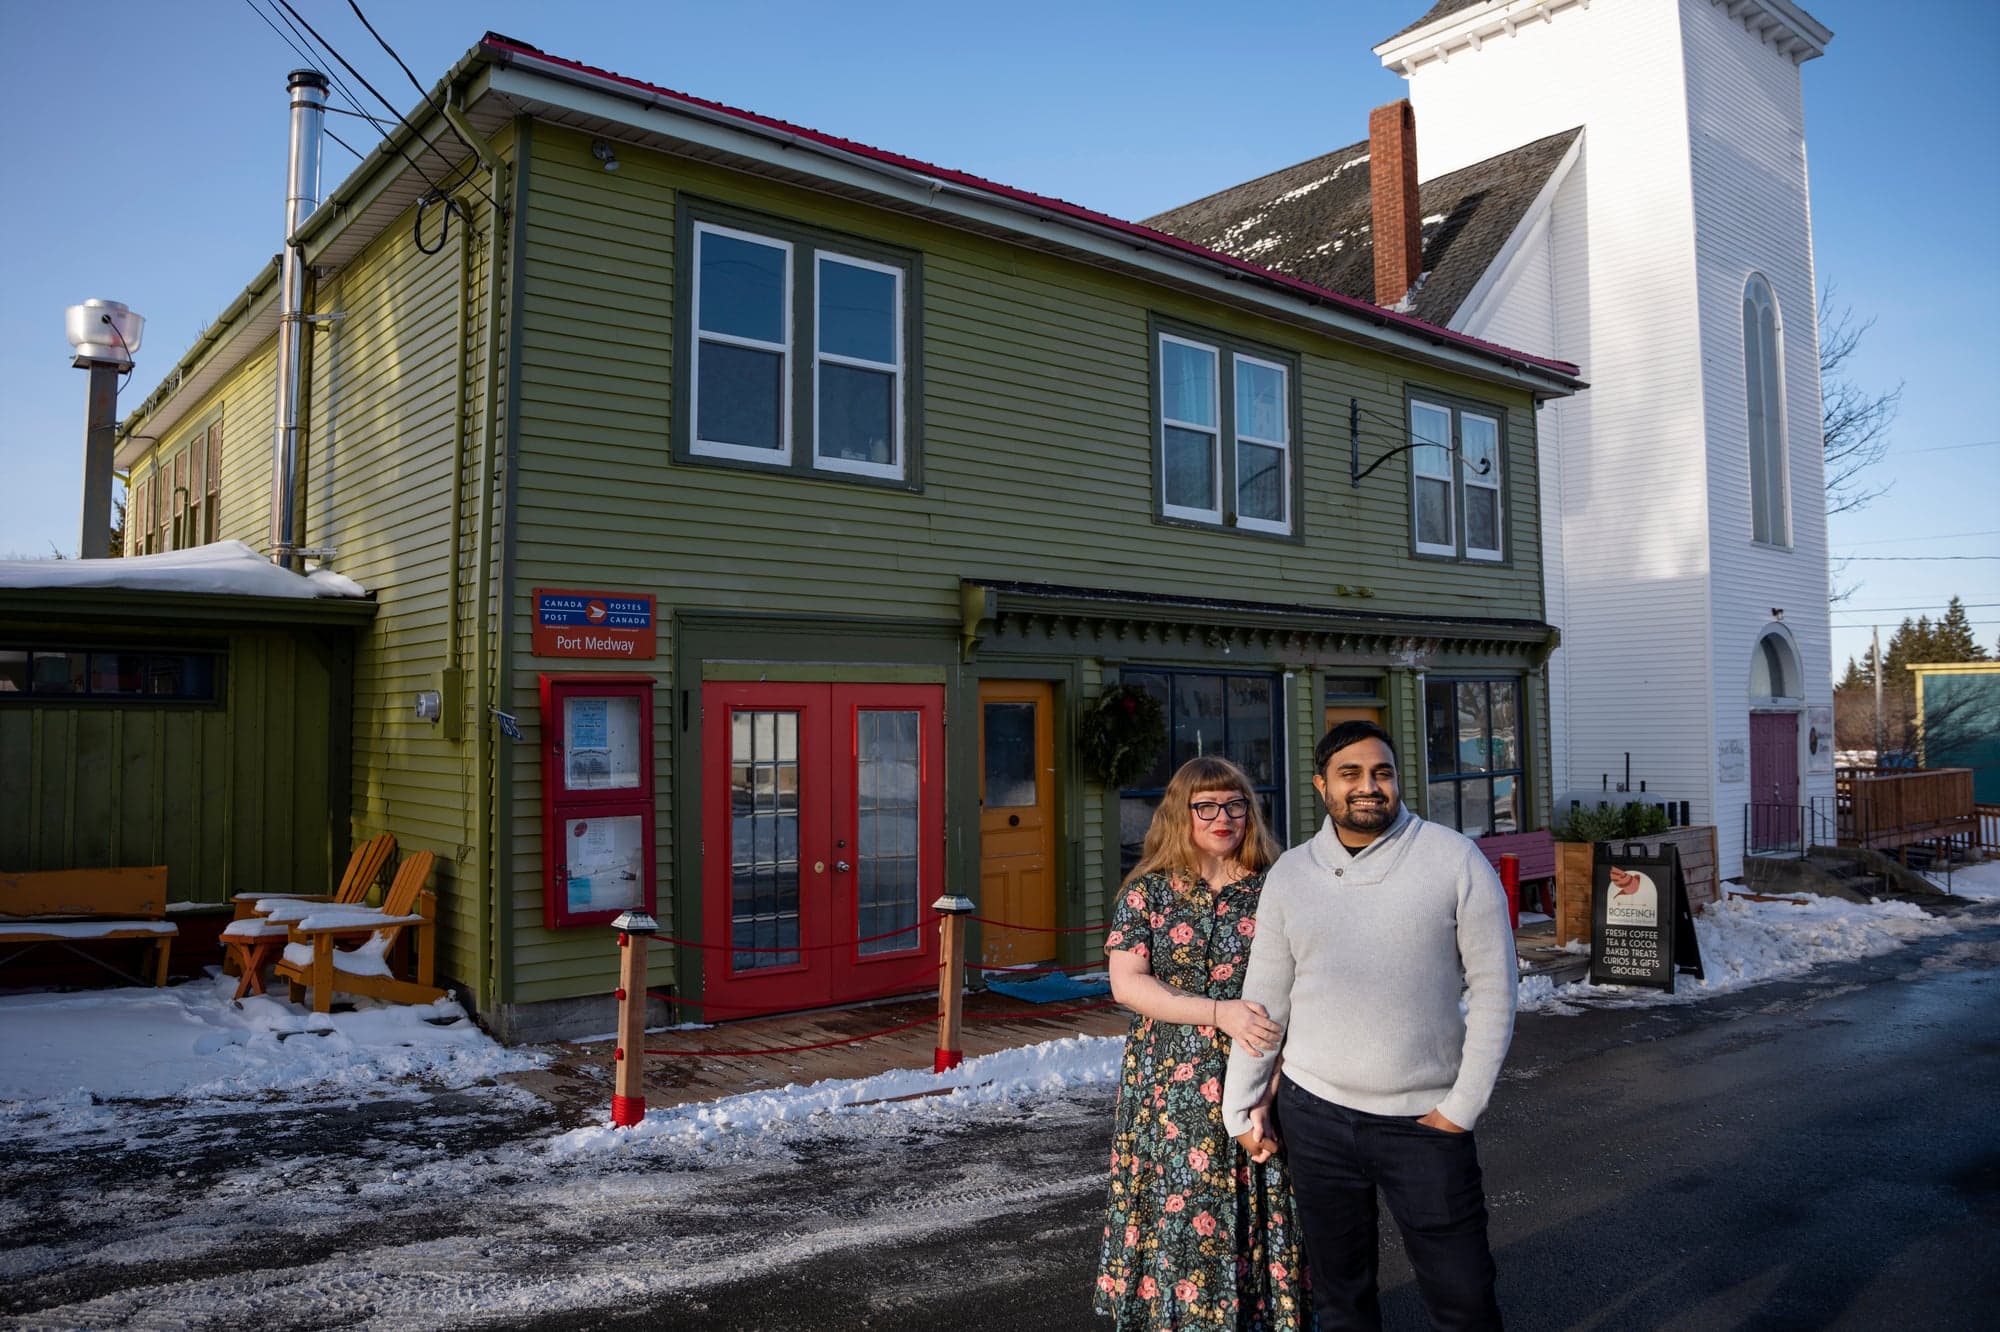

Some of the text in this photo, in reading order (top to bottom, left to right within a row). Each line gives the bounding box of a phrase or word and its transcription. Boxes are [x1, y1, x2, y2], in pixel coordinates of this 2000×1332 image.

[544, 600, 582, 608] CANADA
[610, 603, 641, 611] POSTES
[610, 616, 646, 624] CANADA
[557, 636, 634, 654] Port Medway
[1608, 908, 1656, 918] ROSEFINCH
[1605, 929, 1659, 939] FRESH COFFEE
[1606, 938, 1657, 948] TEA & COCOA
[1605, 947, 1657, 958] BAKED TREATS
[1603, 957, 1660, 968] CURIOS & GIFTS
[1611, 966, 1651, 976] GROCERIES
